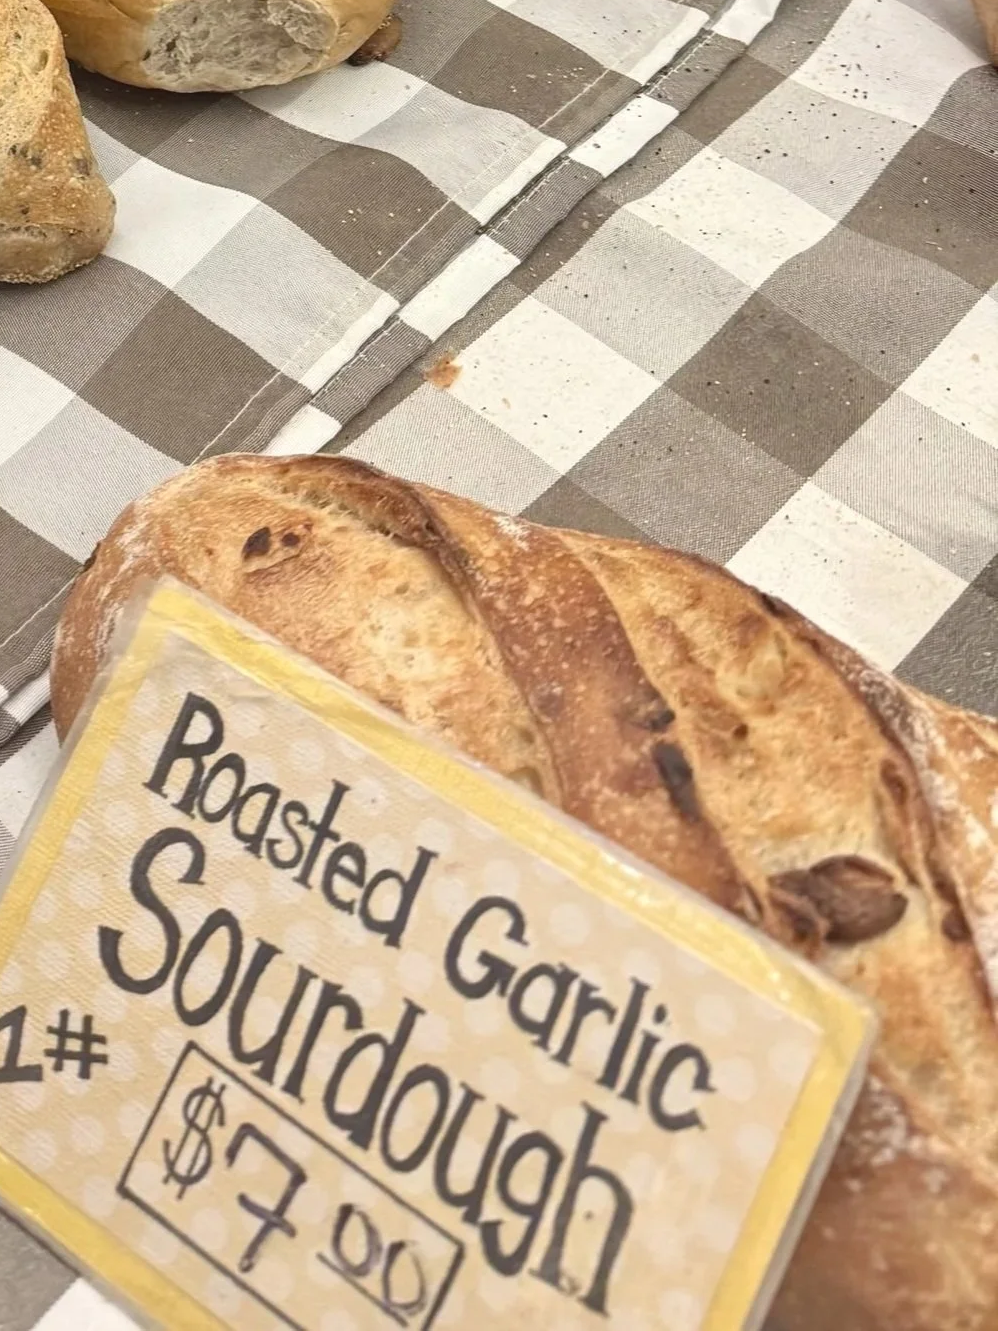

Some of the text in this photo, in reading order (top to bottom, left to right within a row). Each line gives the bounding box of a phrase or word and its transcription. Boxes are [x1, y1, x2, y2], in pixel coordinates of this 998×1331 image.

[96, 825, 635, 1317] Sourdough
[144, 690, 718, 1133] Roasted Garlic
